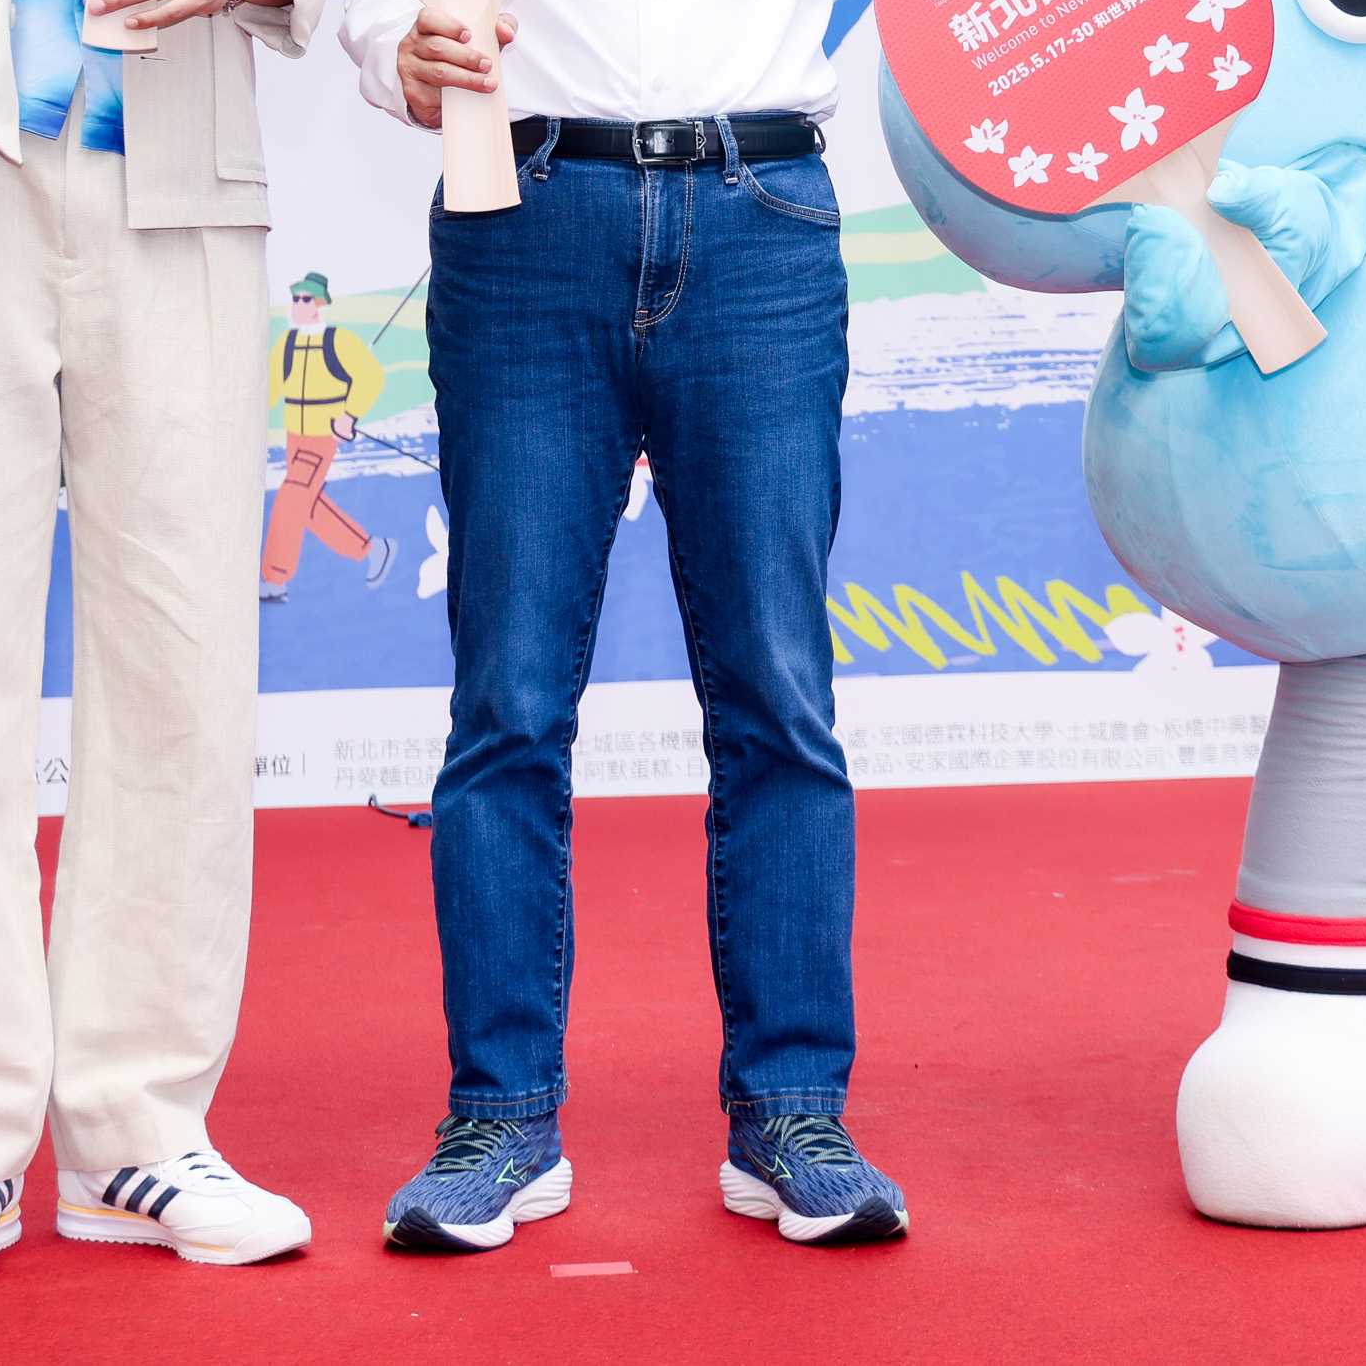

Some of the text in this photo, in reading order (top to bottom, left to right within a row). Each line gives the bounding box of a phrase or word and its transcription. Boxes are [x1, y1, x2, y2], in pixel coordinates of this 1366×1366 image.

[971, 24, 1039, 71] Welcome
[1038, 14, 1056, 28] to
[35, 757, 70, 785] 公
